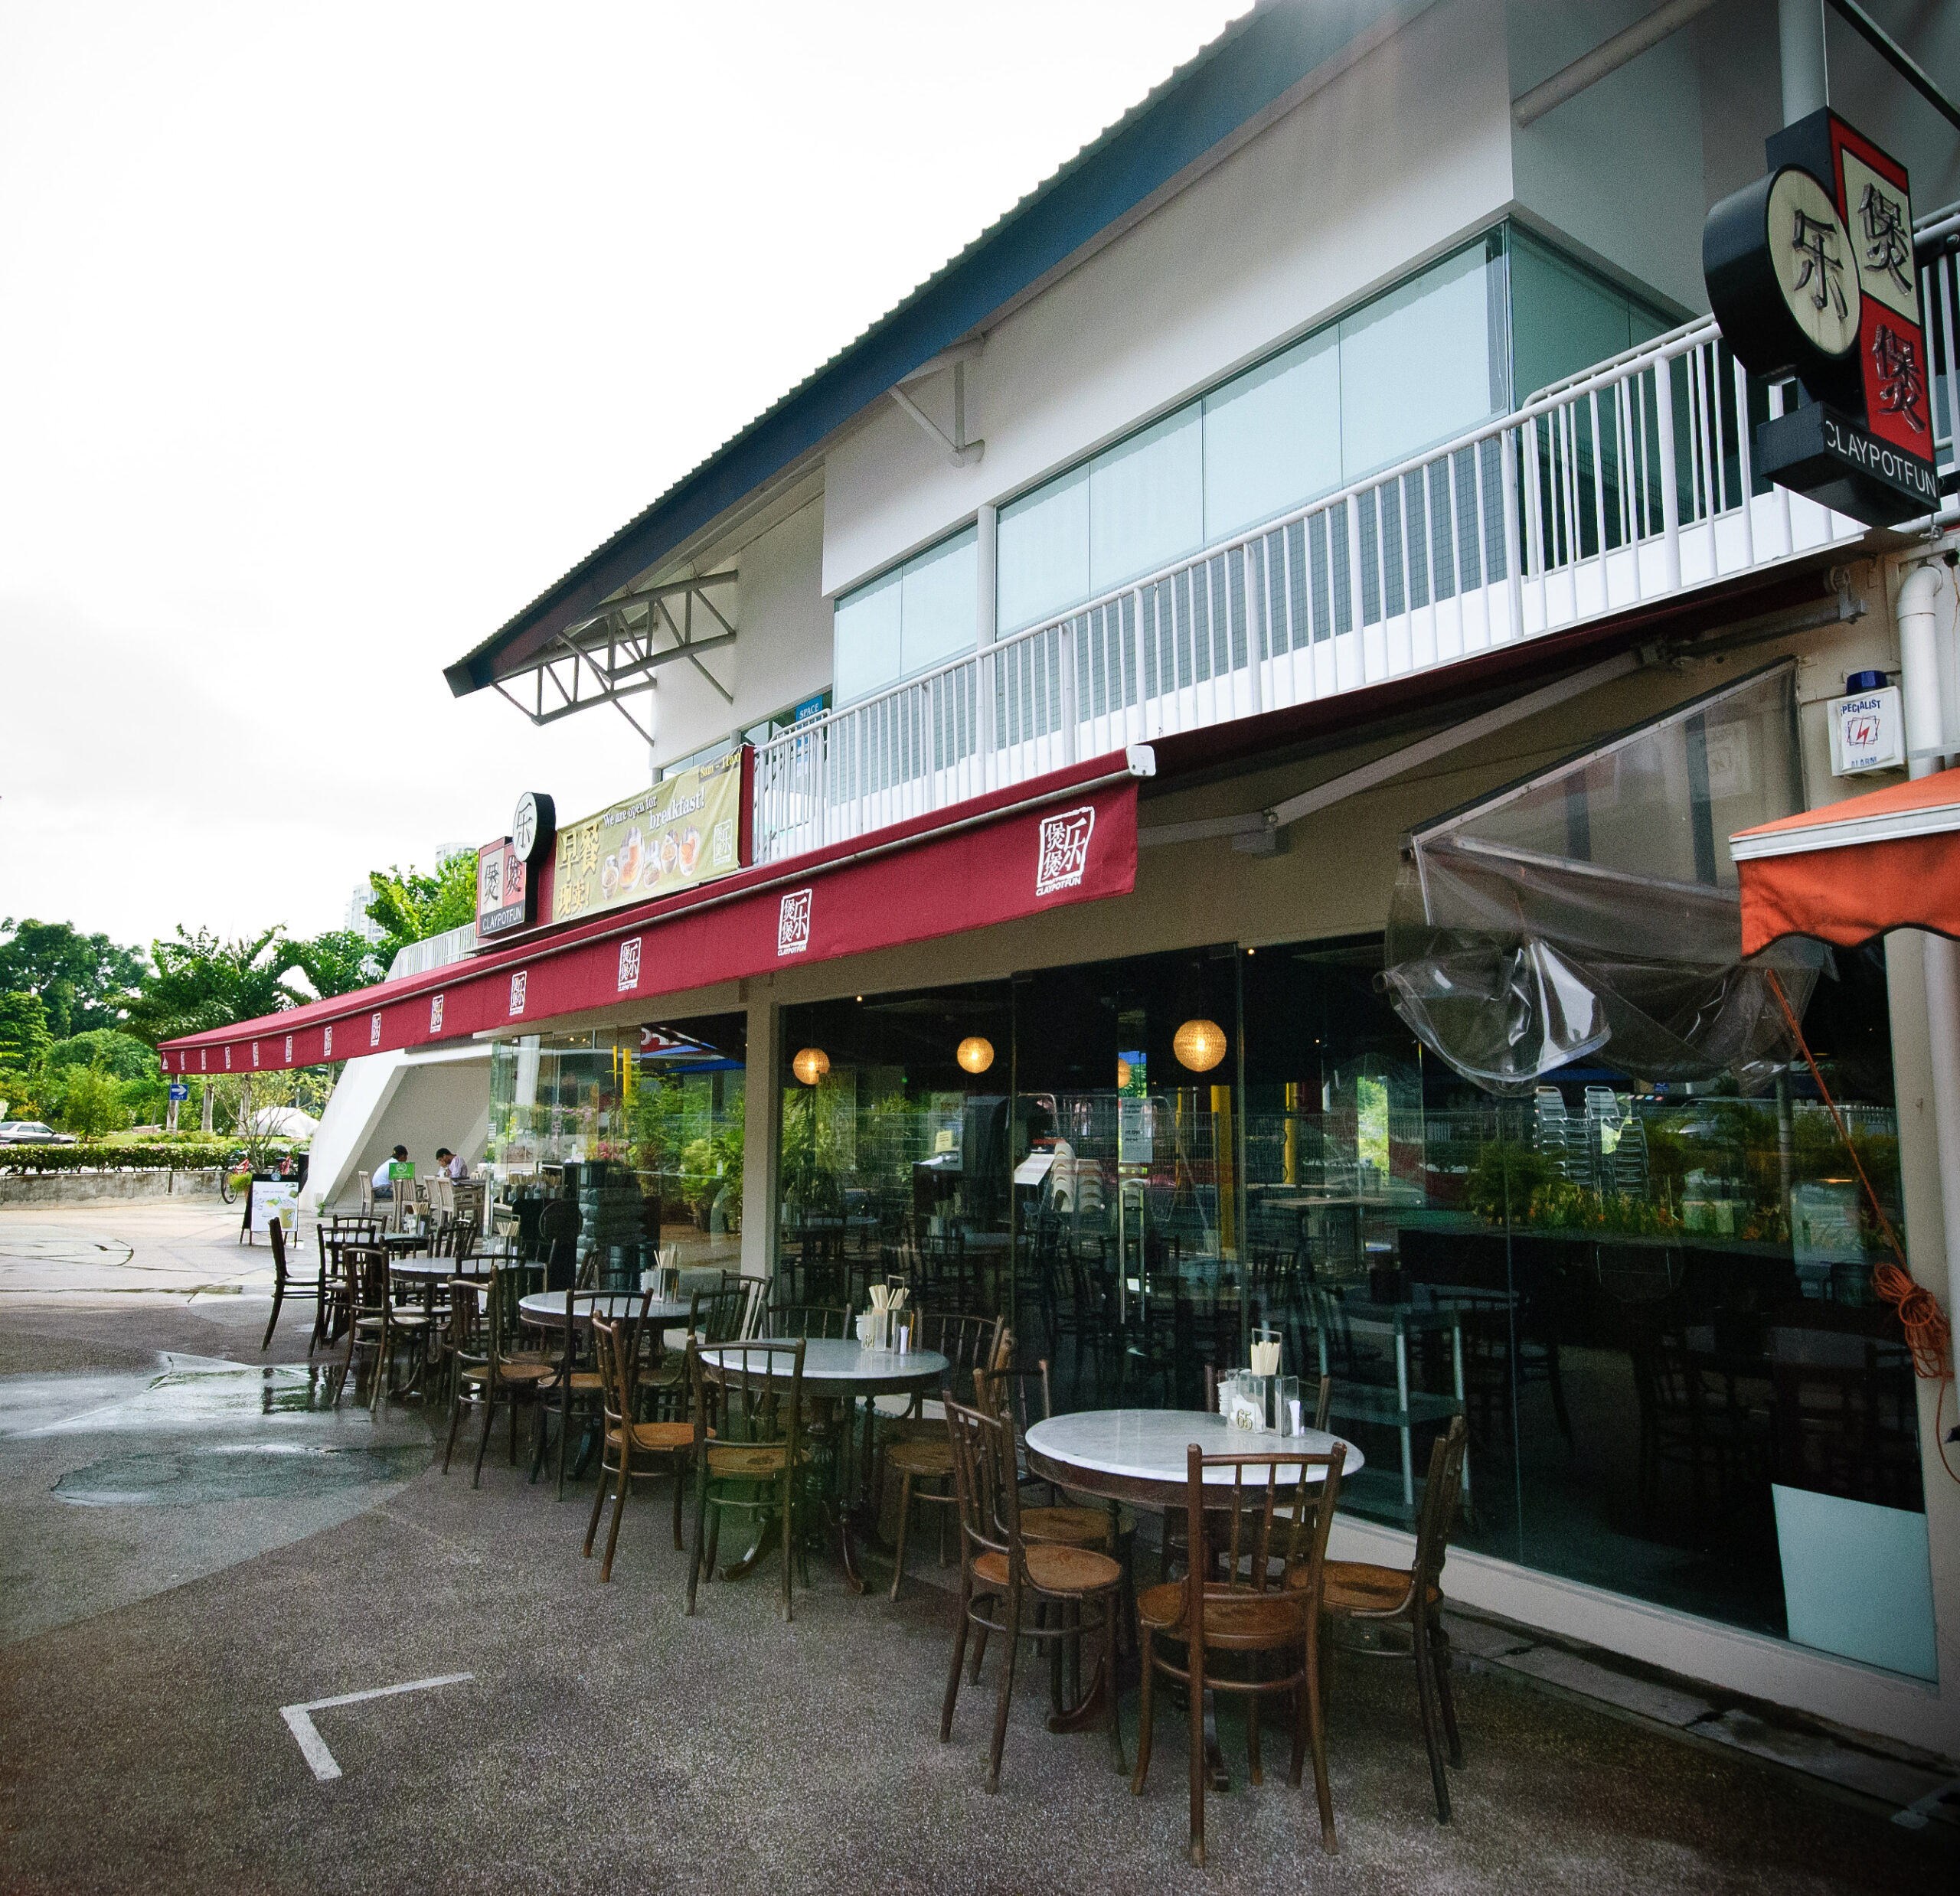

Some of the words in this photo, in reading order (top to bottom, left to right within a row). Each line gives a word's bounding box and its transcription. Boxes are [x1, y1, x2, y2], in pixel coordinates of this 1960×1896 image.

[1792, 208, 1848, 319] 乐
[1826, 420, 1937, 498] CLAYPOTFUN
[799, 703, 819, 720] SPACE
[1840, 699, 1881, 716] PECIALIST
[516, 801, 533, 848] 乐
[603, 813, 616, 829] We
[616, 808, 628, 824] are
[629, 803, 646, 821] open
[646, 795, 657, 811] for
[649, 785, 706, 831] breakfast!
[560, 821, 600, 883] 早餐
[1036, 876, 1081, 896] CLAYPOTFUN
[482, 906, 522, 932] CLAYPOTFUN
[1236, 1409, 1253, 1431] 65
